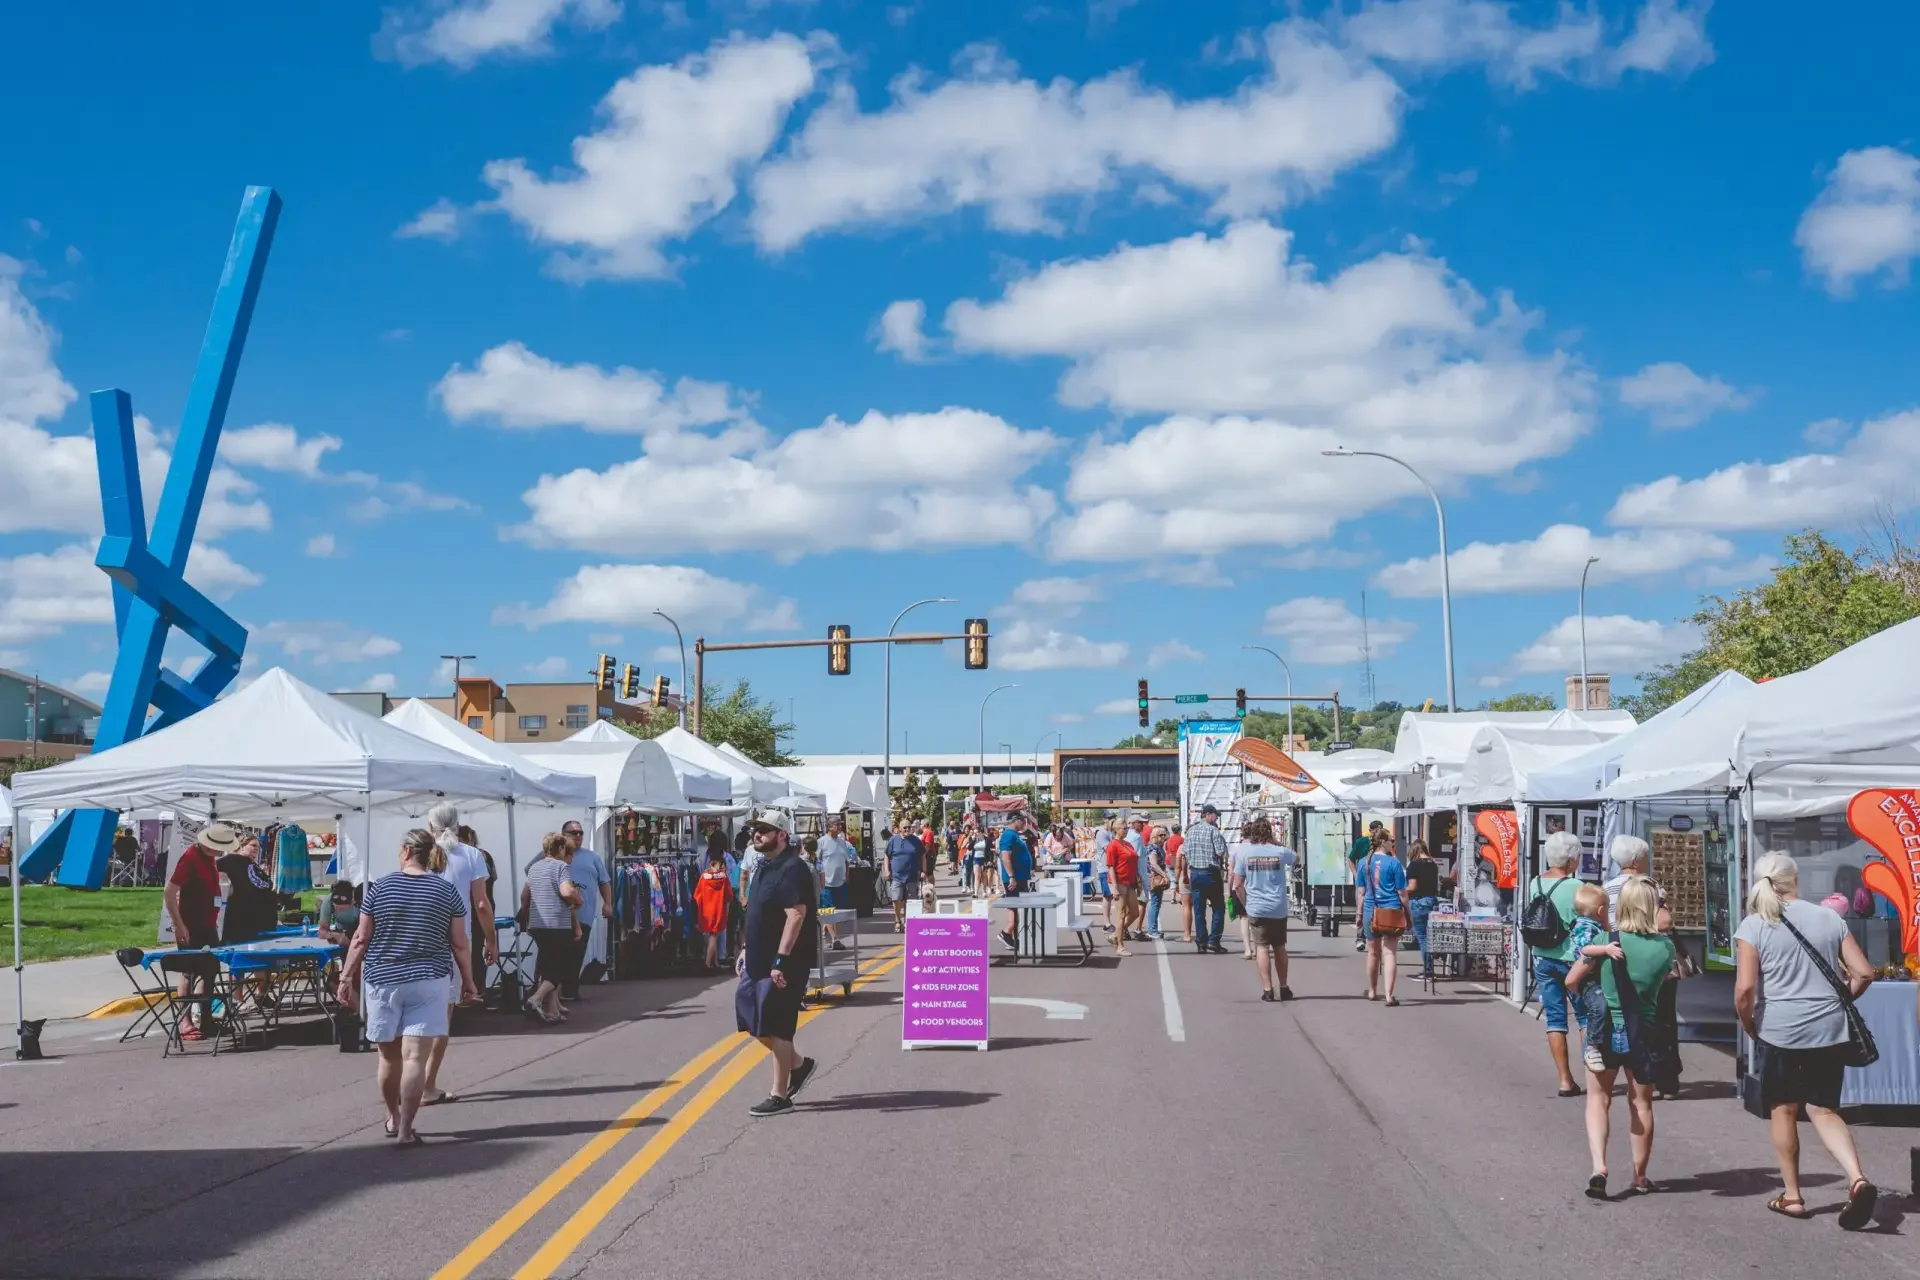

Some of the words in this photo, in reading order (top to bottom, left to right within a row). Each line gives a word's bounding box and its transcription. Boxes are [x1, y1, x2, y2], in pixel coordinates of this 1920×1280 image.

[1490, 814, 1512, 876] EXCELLENCE
[1880, 795, 1920, 927] EXCELL
[922, 949, 948, 957] ARTIST
[950, 949, 982, 957] BOOTHS
[922, 966, 937, 974] ART
[938, 966, 980, 974] ACTIVITIES
[921, 983, 939, 991] KIDS
[940, 983, 956, 991] FUN
[958, 983, 980, 991] ZONE
[920, 1018, 944, 1026] FOOD
[946, 1018, 984, 1026] VENDORS
